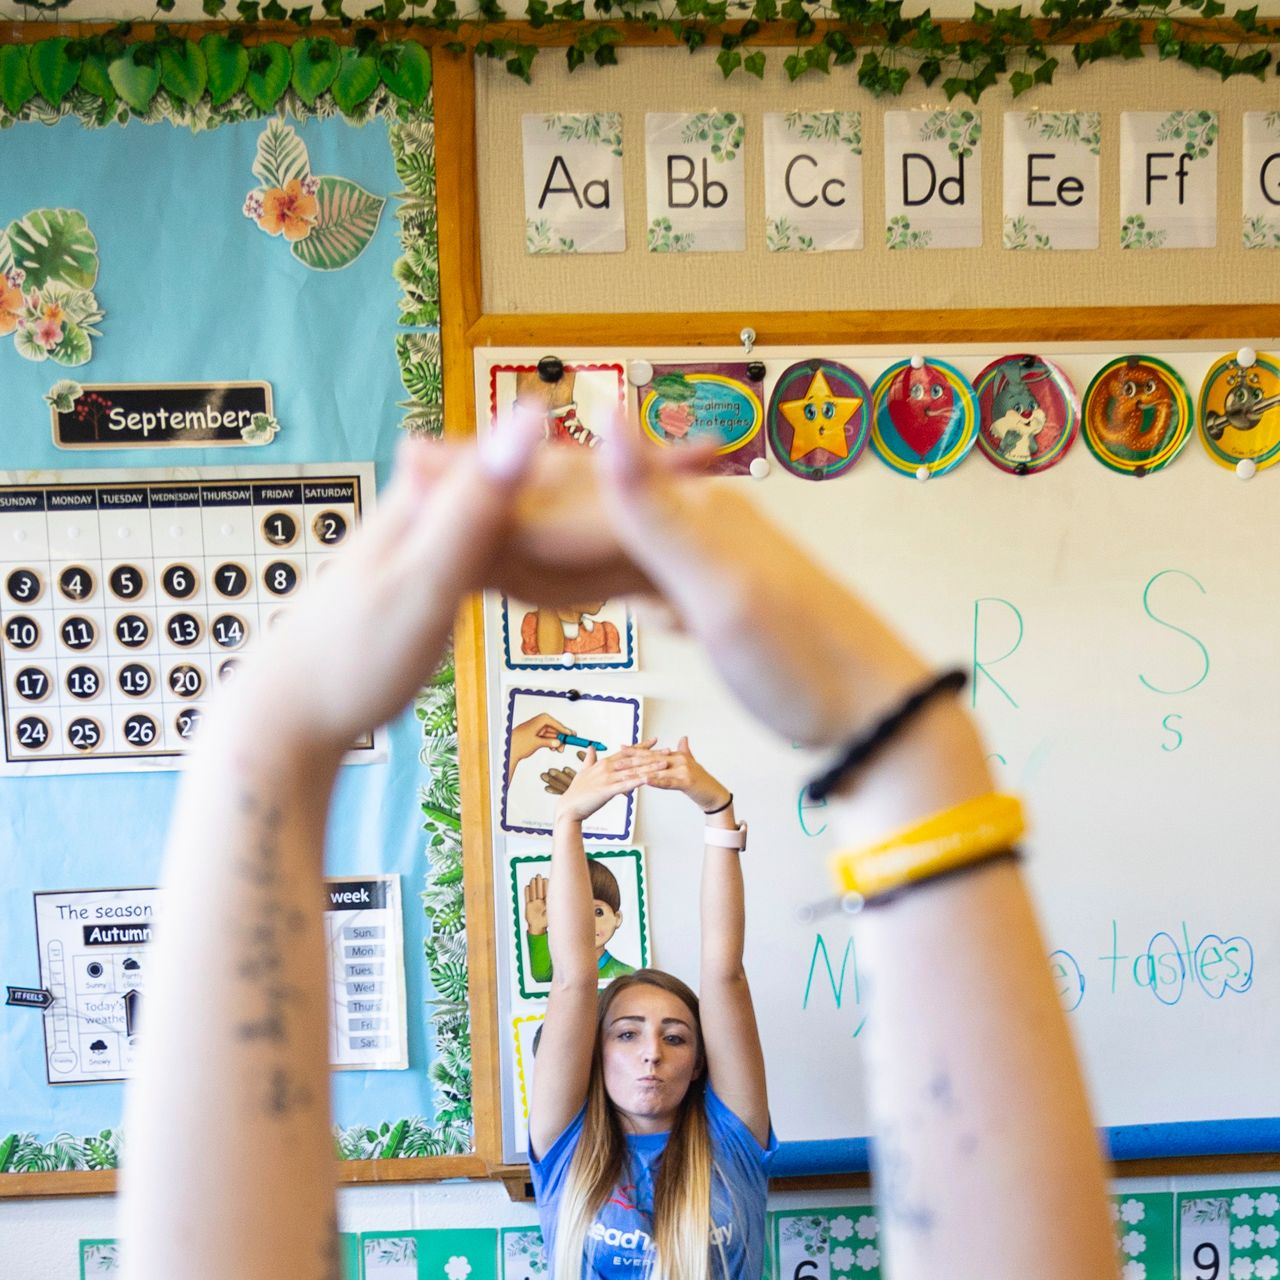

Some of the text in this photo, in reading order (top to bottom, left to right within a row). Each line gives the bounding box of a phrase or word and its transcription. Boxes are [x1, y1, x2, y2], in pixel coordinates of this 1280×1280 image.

[537, 155, 611, 210] Aa
[666, 153, 729, 210] Bb
[784, 154, 846, 208] Cc
[902, 152, 965, 208] Dd
[1026, 153, 1085, 207] Ee
[1145, 152, 1193, 206] Ff
[108, 406, 251, 437] September
[0, 487, 354, 507] SUNDAY MONDAY TUESDAY WEDNESDAY THURSDAY FRIDAY SATURDAY
[274, 520, 337, 539] 1 2
[16, 570, 287, 597] 3 4 5 6 7 8
[10, 620, 242, 644] 10 11 12 13 14
[973, 569, 1210, 709] R S
[20, 675, 45, 695] 17
[70, 673, 97, 694] 18
[122, 671, 149, 691] 19
[173, 671, 199, 692] 20
[20, 723, 46, 742] 24
[71, 723, 98, 744] 25
[127, 722, 153, 742] 26
[330, 888, 371, 904] week
[56, 904, 153, 920] The season
[89, 927, 152, 943] Autumn
[22, 992, 44, 1001] FEELS
[85, 1001, 125, 1013] Today's
[85, 1016, 125, 1025] weathe
